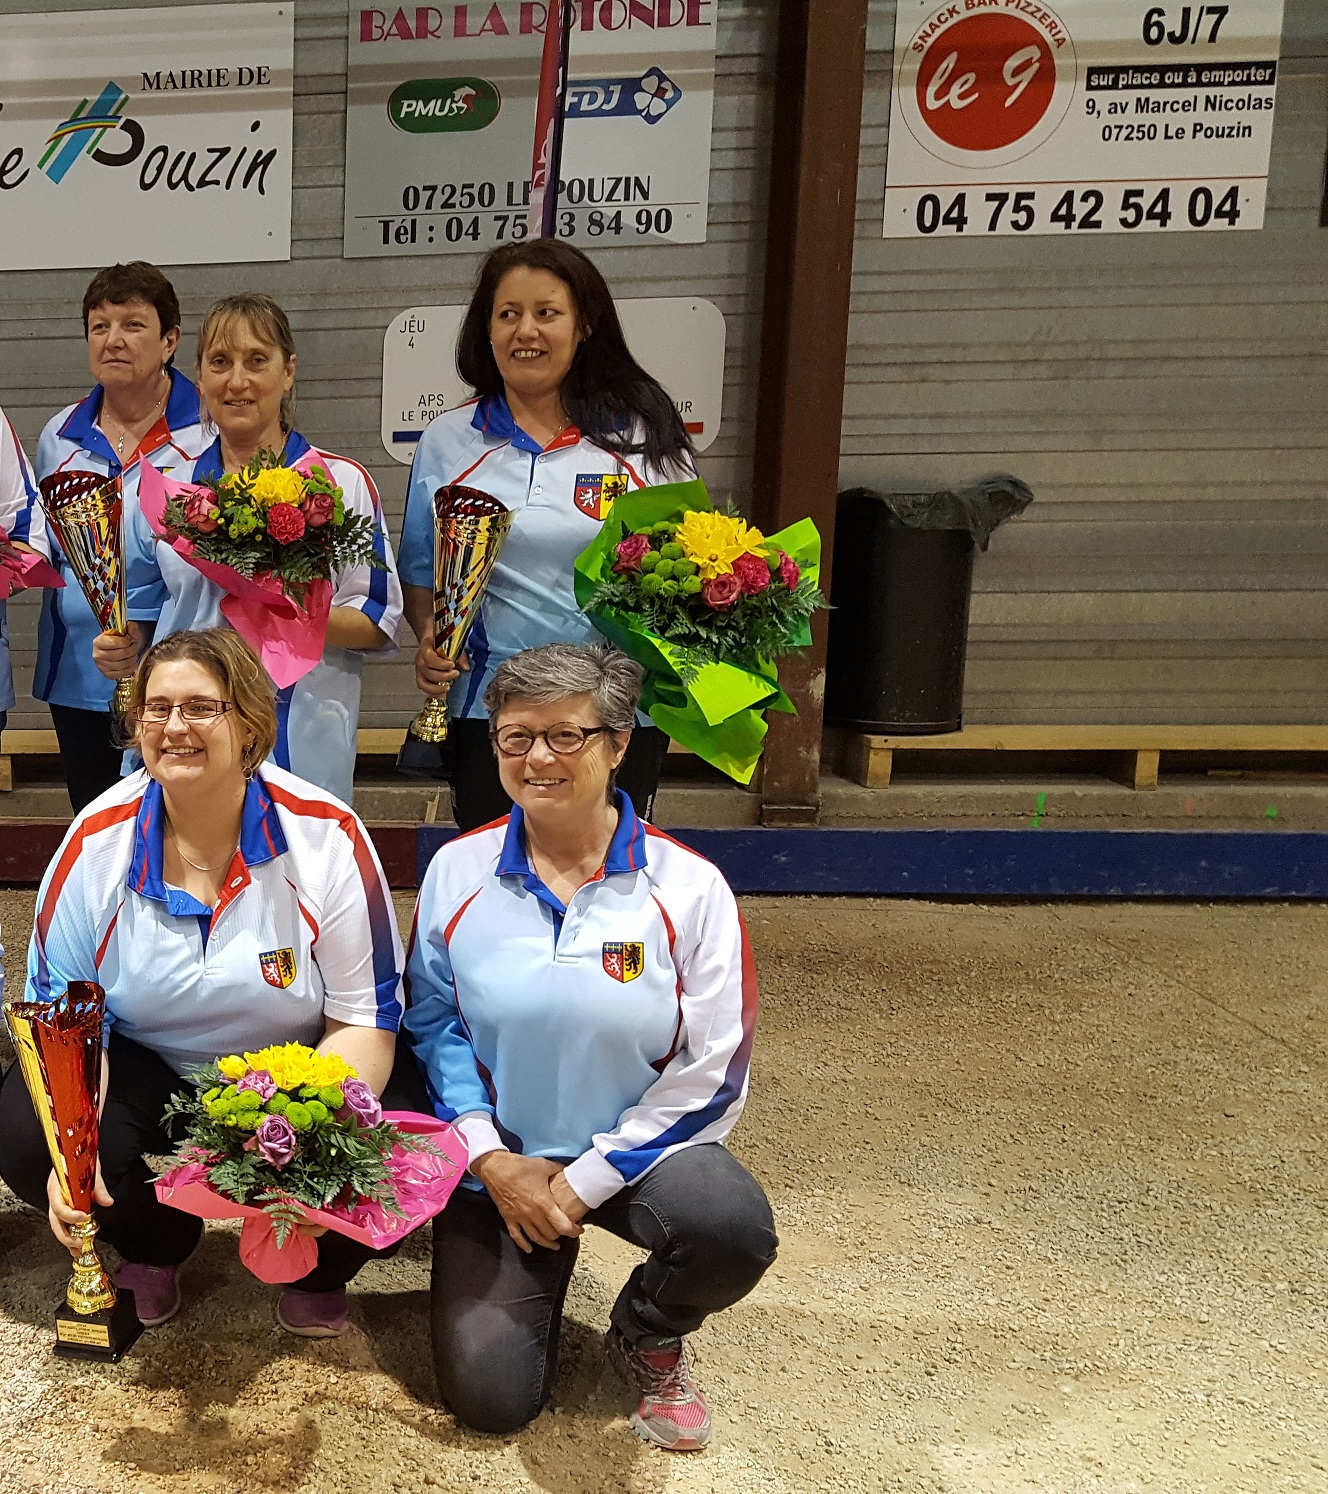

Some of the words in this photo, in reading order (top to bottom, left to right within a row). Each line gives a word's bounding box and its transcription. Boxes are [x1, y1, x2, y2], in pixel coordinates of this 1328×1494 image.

[360, 7, 442, 42] BAR
[454, 2, 509, 37] LA
[519, 0, 711, 34] RTONDE
[912, 4, 960, 53] SNACK
[1004, 0, 1067, 49] PIZZERIA
[1142, 5, 1229, 46] 6J/7
[141, 67, 230, 91] MAIRIE
[236, 66, 271, 86] DE
[926, 51, 979, 110] le
[1090, 71, 1115, 86] sur
[1118, 68, 1161, 89] place
[1164, 70, 1184, 84] ou
[1187, 67, 1197, 83] à
[1201, 66, 1273, 87] emporter
[400, 97, 450, 118] PMU
[566, 85, 622, 111] FDJ
[1085, 98, 1102, 118] 9,
[1107, 100, 1128, 114] av
[1134, 96, 1198, 114] Marcel
[1204, 93, 1274, 112] Nicolas
[37, 81, 278, 195] Pouzin
[1101, 124, 1157, 142] 07250
[1163, 123, 1185, 140] Le
[1191, 121, 1253, 140] Pouzin
[403, 182, 495, 211] 07250
[916, 193, 968, 233] 04
[984, 191, 1036, 232] 75
[1050, 189, 1104, 230] 42
[1119, 187, 1172, 229] 54
[1187, 185, 1240, 226] 04
[445, 216, 481, 242] 04
[493, 214, 529, 240] 75
[557, 212, 576, 237] 3
[587, 209, 623, 235] 84
[635, 207, 672, 234] 90
[399, 319, 426, 334] JEU
[408, 336, 415, 349] 4
[417, 393, 444, 407] APS
[402, 410, 415, 421] LE
